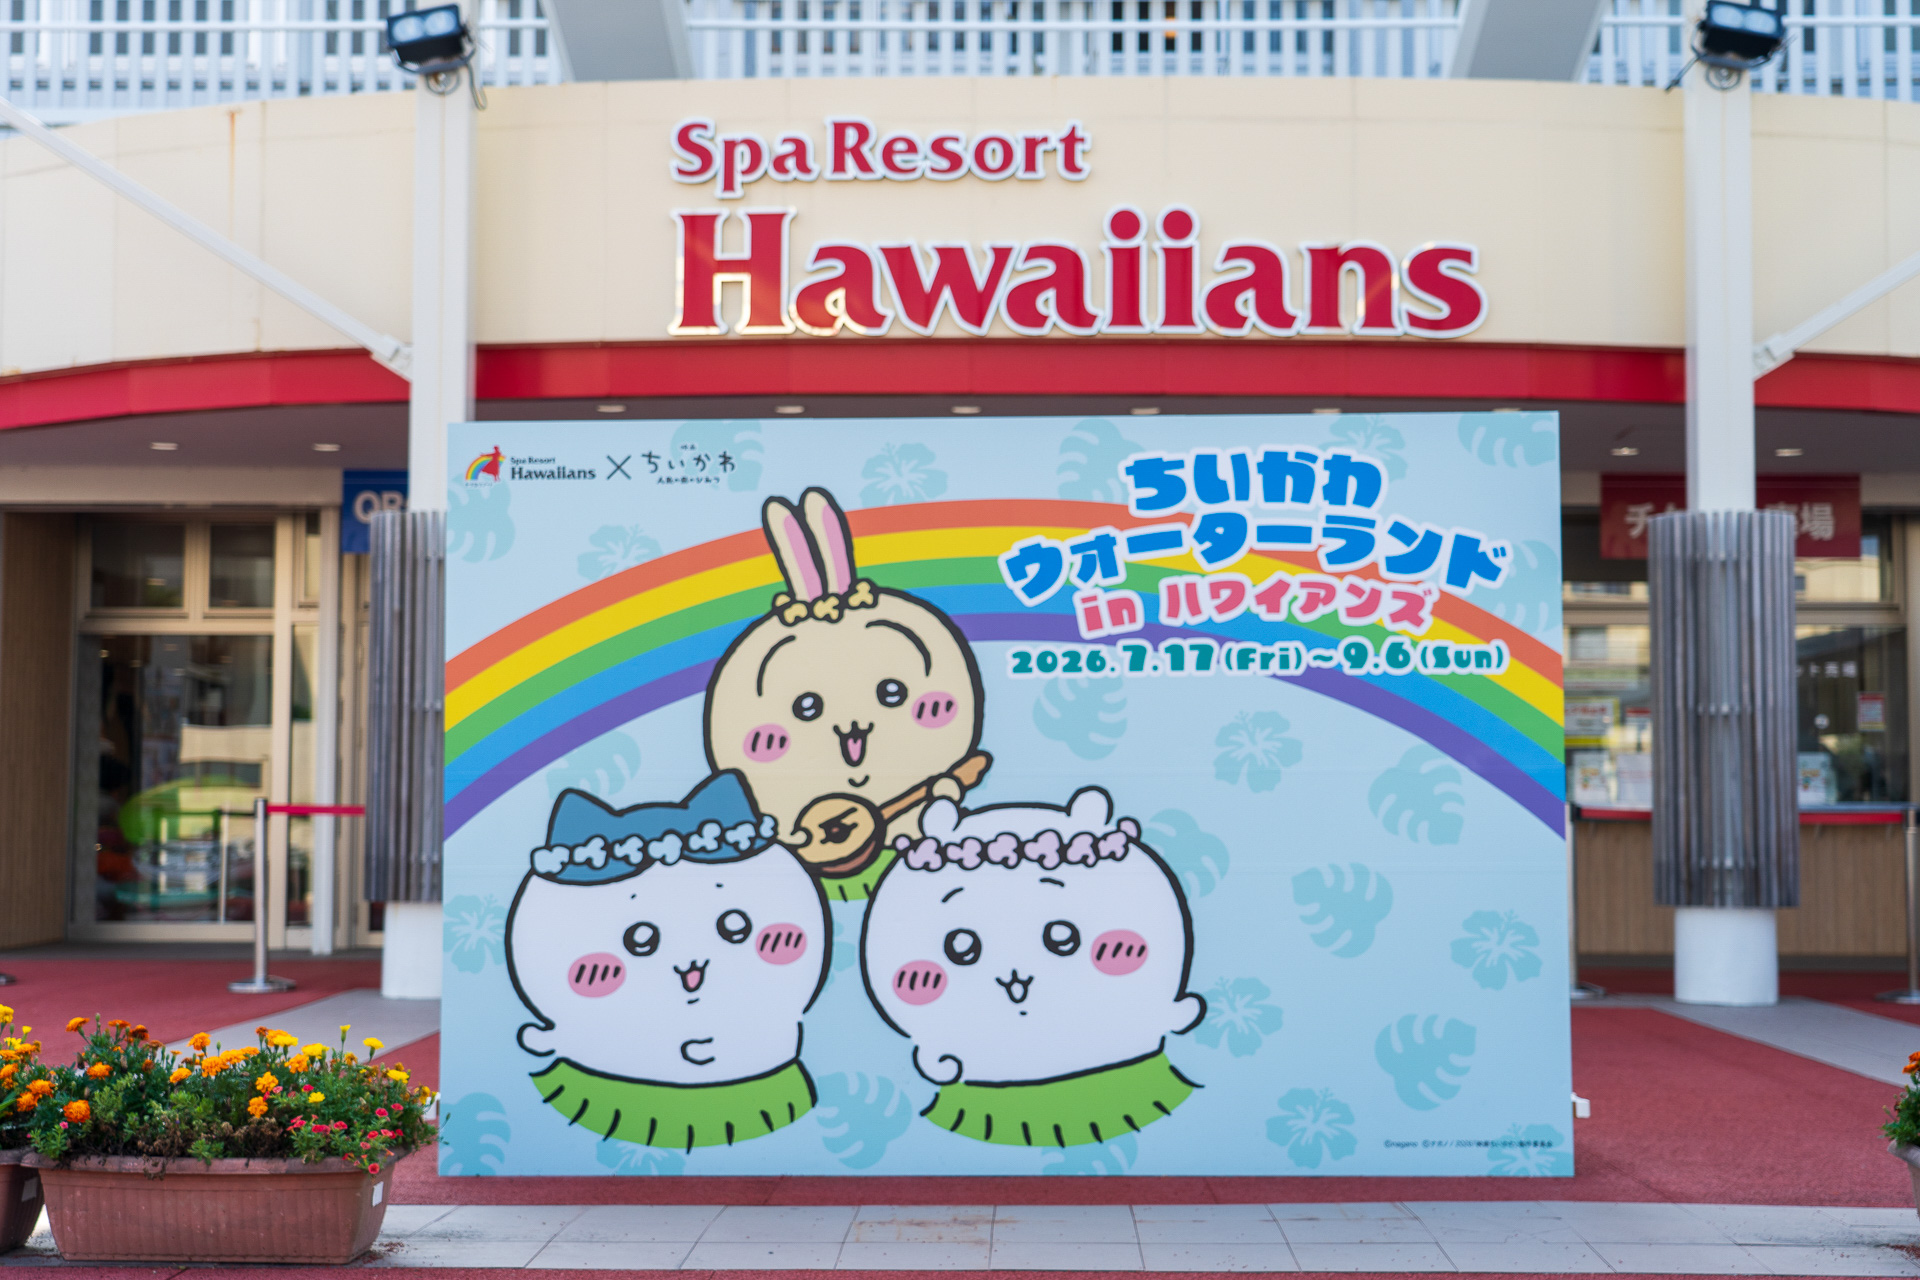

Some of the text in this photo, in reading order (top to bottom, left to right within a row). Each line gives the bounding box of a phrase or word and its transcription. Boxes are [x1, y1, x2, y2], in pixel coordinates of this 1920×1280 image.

[673, 118, 1089, 195] Spa Resort
[674, 206, 1486, 334] Hawaiians
[510, 466, 597, 481] Hawaiians
[641, 450, 736, 474] ちいかわ
[1124, 450, 1383, 512] ちいかわ
[1079, 577, 1434, 633] in ハワイアンズ
